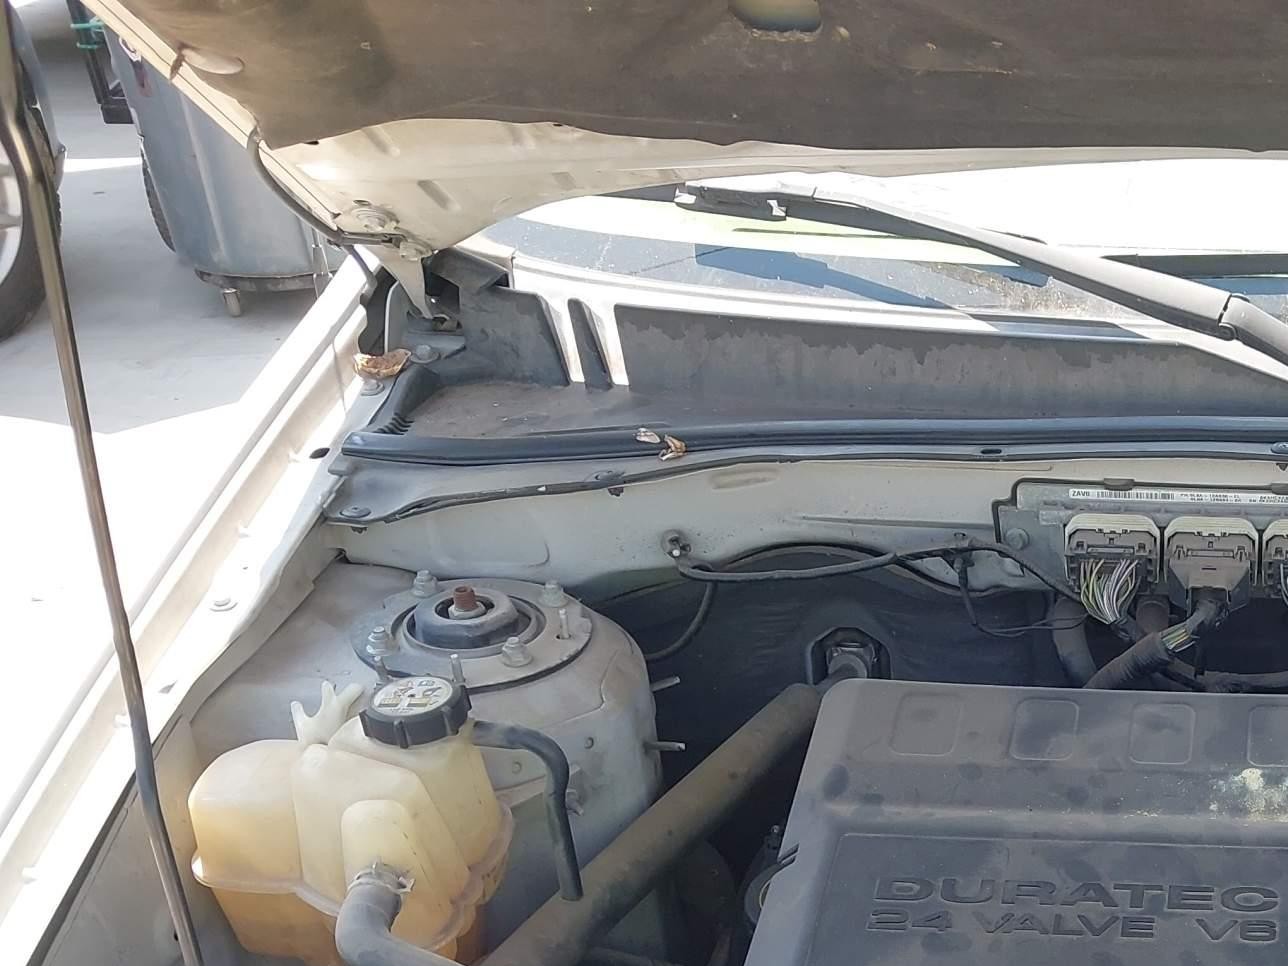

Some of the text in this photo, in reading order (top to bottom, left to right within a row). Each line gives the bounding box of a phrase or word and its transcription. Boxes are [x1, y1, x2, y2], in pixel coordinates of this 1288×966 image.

[872, 877, 1280, 913] DURATEC
[865, 909, 1279, 943] 24 VALVE V6
